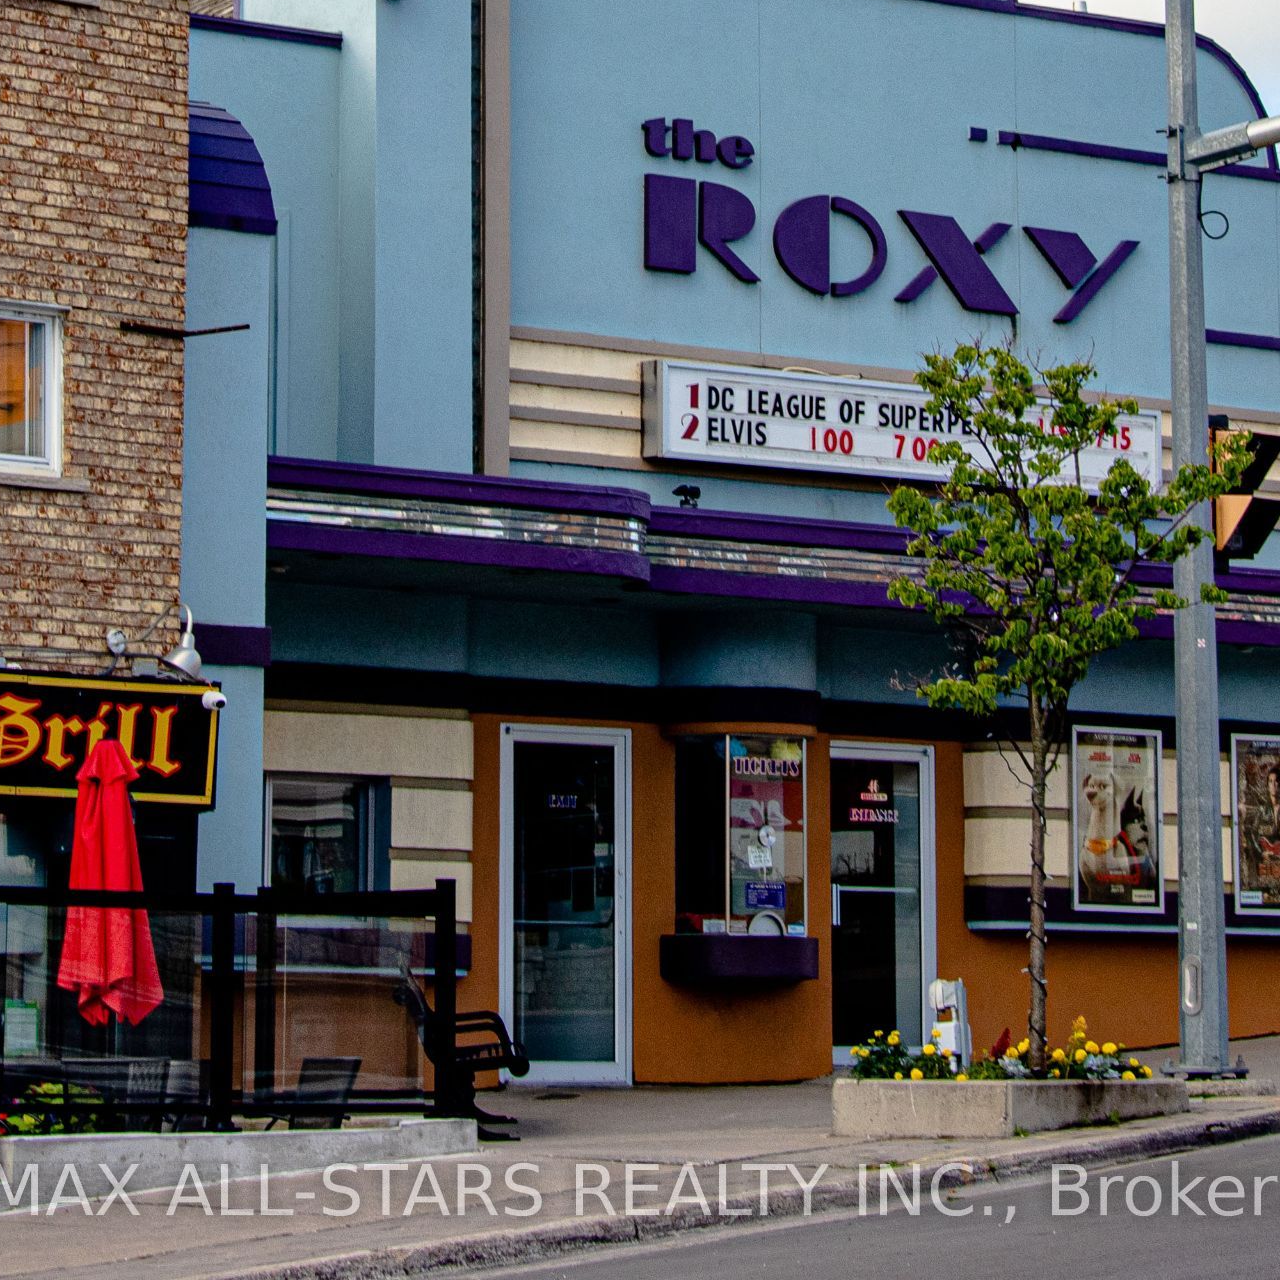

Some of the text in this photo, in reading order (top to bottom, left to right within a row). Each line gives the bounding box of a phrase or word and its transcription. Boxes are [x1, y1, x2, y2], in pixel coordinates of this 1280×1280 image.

[641, 117, 755, 169] the
[643, 173, 1141, 324] ROXY
[686, 383, 699, 409] 1
[708, 385, 734, 412] DC
[747, 389, 826, 420] LEAGUE
[839, 399, 865, 424] OF
[681, 413, 700, 441] 2
[707, 418, 767, 446] ELVIS
[733, 757, 800, 776] TICKETS
